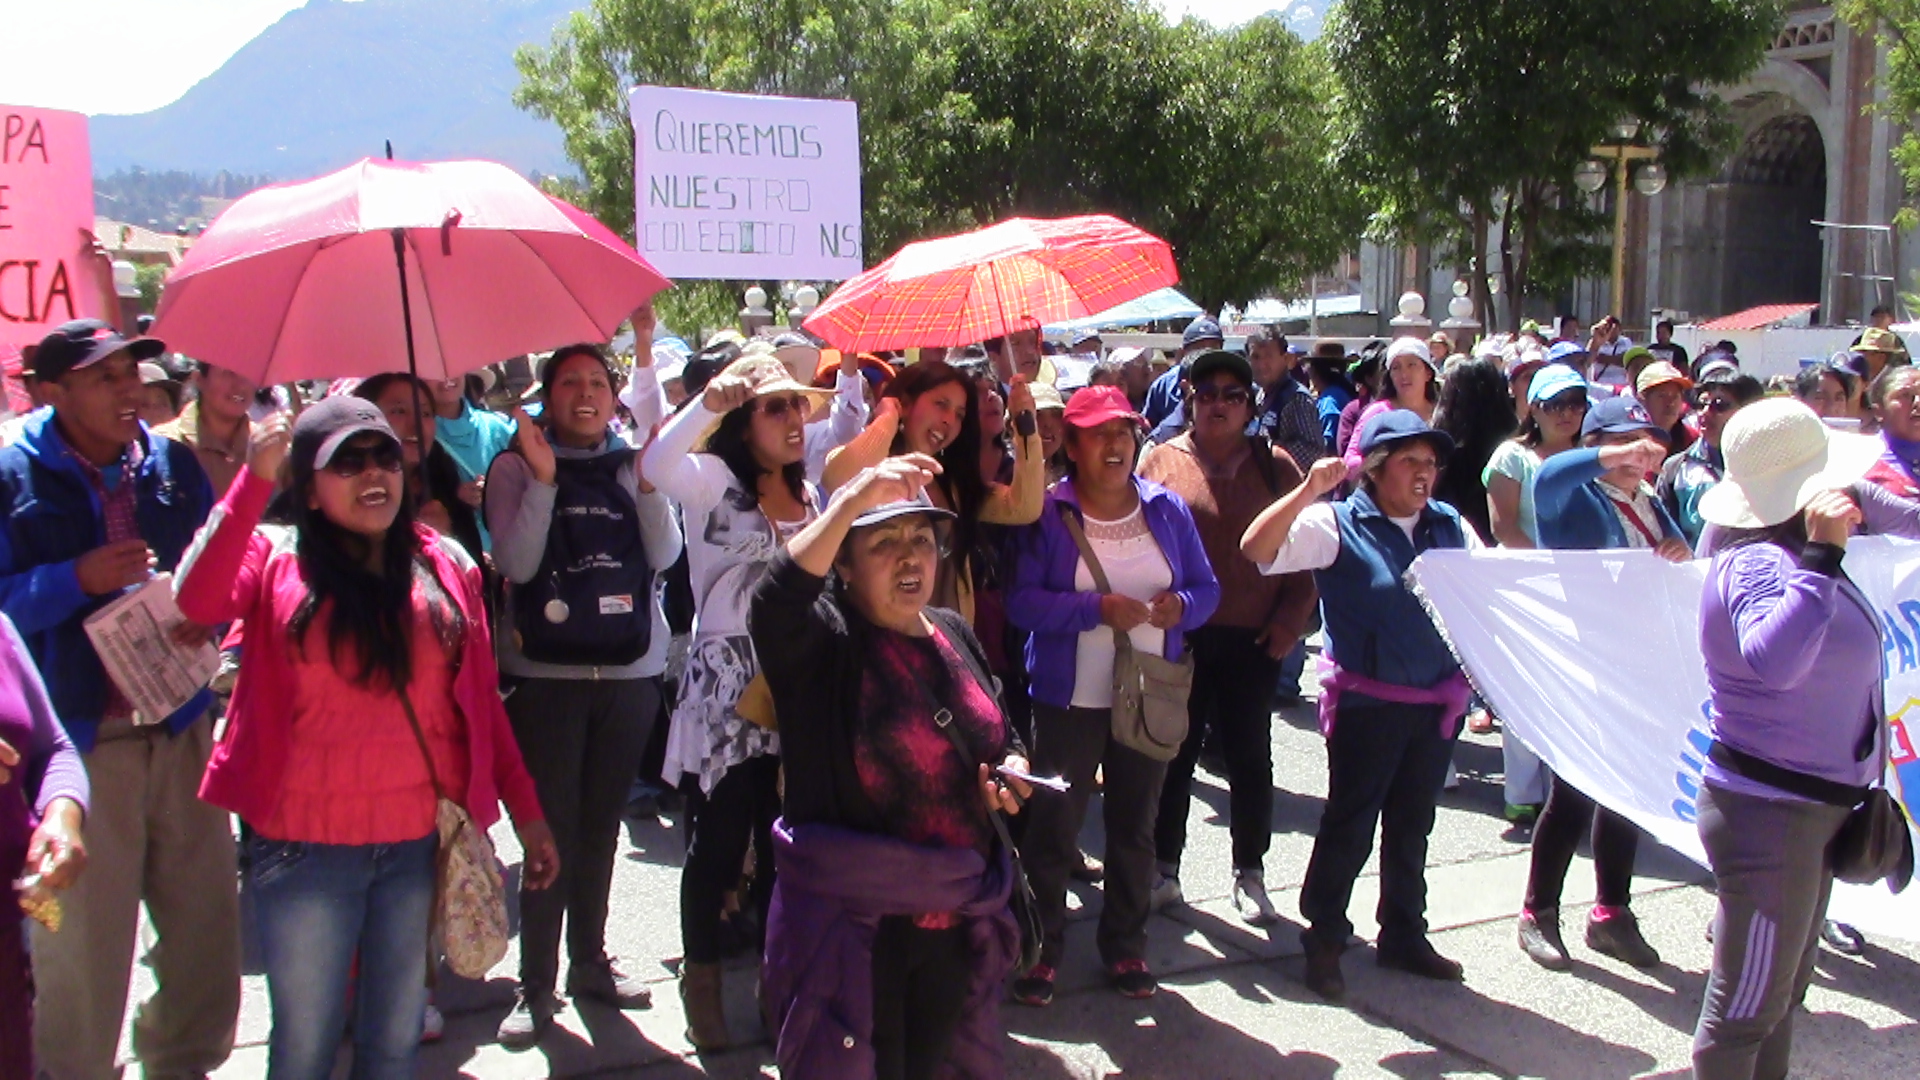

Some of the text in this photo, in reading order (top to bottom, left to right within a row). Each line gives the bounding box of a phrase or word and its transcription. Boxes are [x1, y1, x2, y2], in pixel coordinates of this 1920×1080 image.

[3, 114, 49, 164] PA
[654, 109, 823, 160] QUEREMOS
[650, 174, 812, 212] NUESTRO
